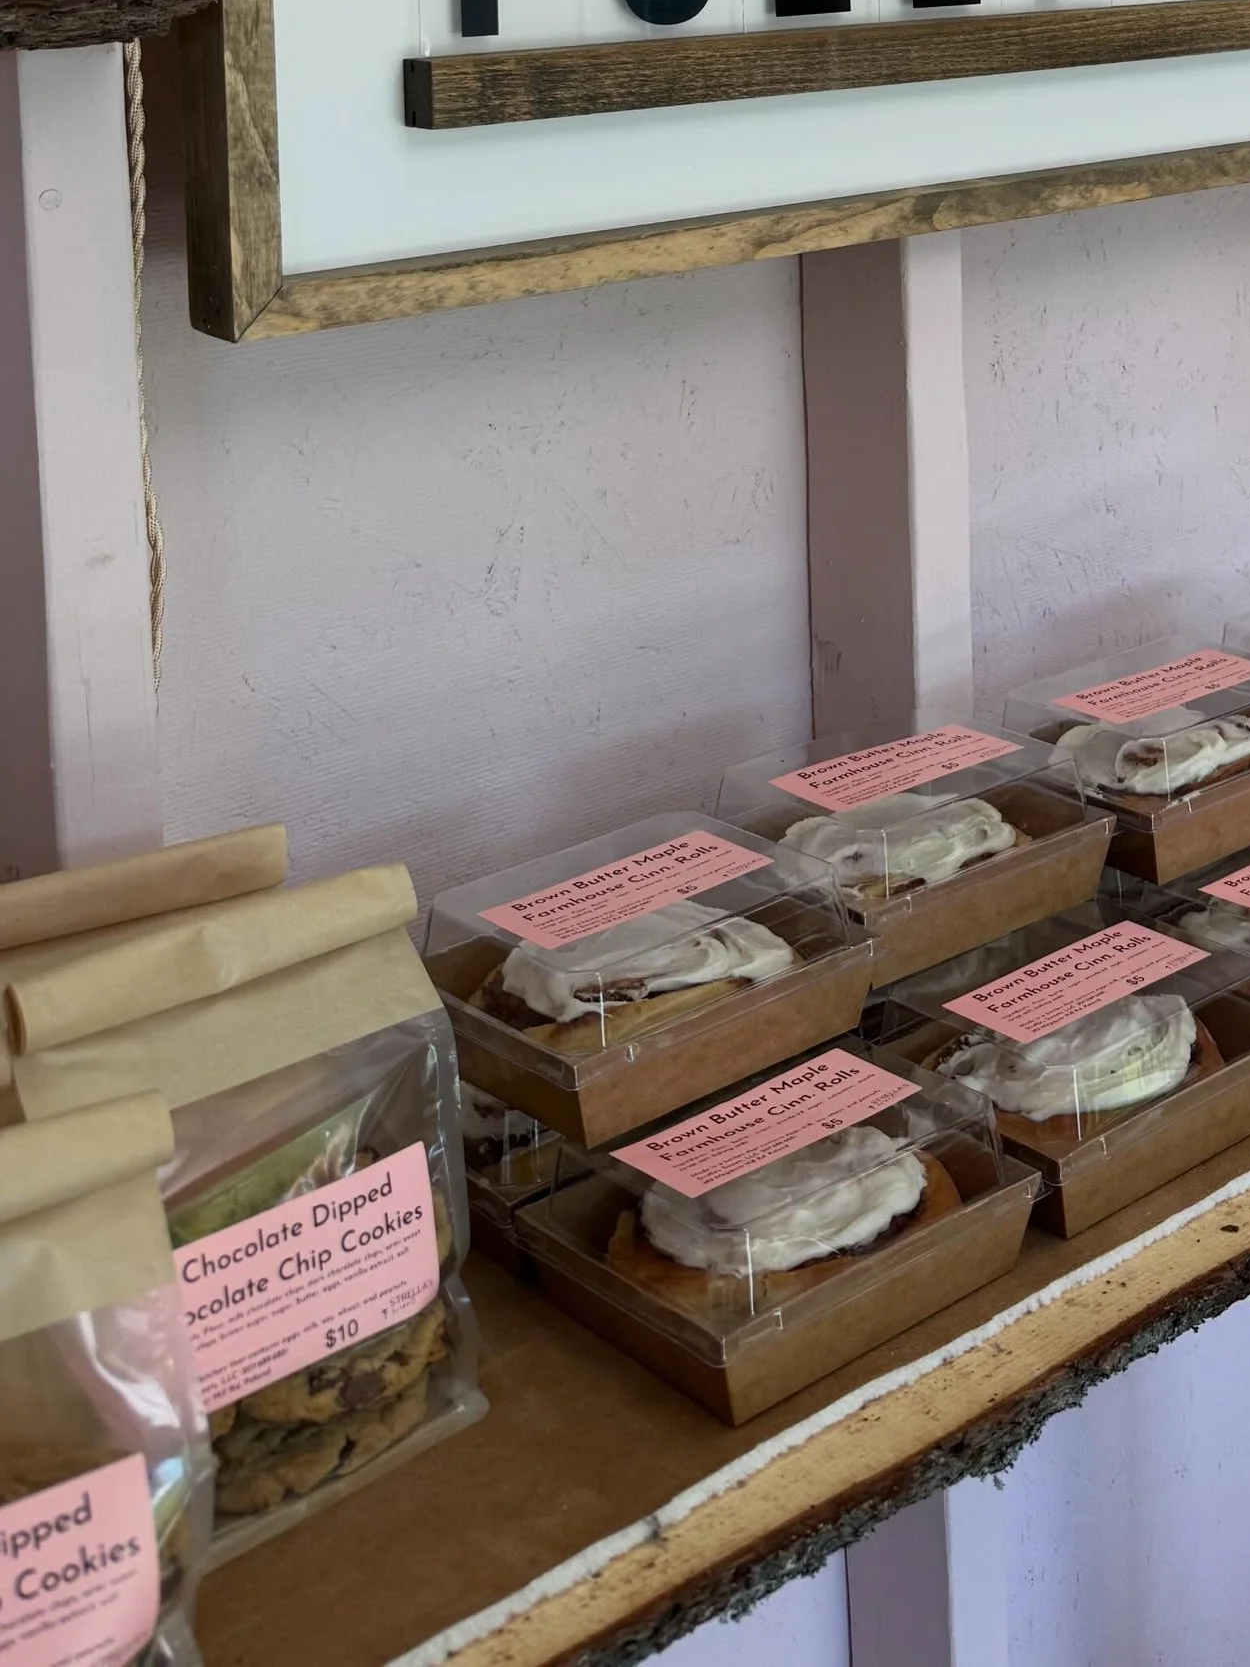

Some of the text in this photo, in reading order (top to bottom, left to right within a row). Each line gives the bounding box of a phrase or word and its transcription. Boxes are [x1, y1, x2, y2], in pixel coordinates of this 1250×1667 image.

[511, 843, 689, 911] Brown Butter Maple
[522, 884, 625, 921] Farmhouse
[674, 846, 718, 864] Rolls
[972, 932, 1122, 1002] Brown Butter Maple
[987, 972, 1074, 1013] Farmhouse
[1113, 937, 1151, 953] Rolls
[646, 1065, 828, 1151] Brown Butter Maple
[659, 1118, 765, 1161] Farmhouse
[814, 1069, 859, 1091] Rolls
[822, 1118, 843, 1129] $5
[183, 1172, 392, 1283] Chocolate Dipped
[187, 1206, 423, 1325] ocolate Chip Cookies
[326, 1319, 358, 1349] $10
[0, 1490, 92, 1558] ipped
[14, 1536, 140, 1600] Cookies
